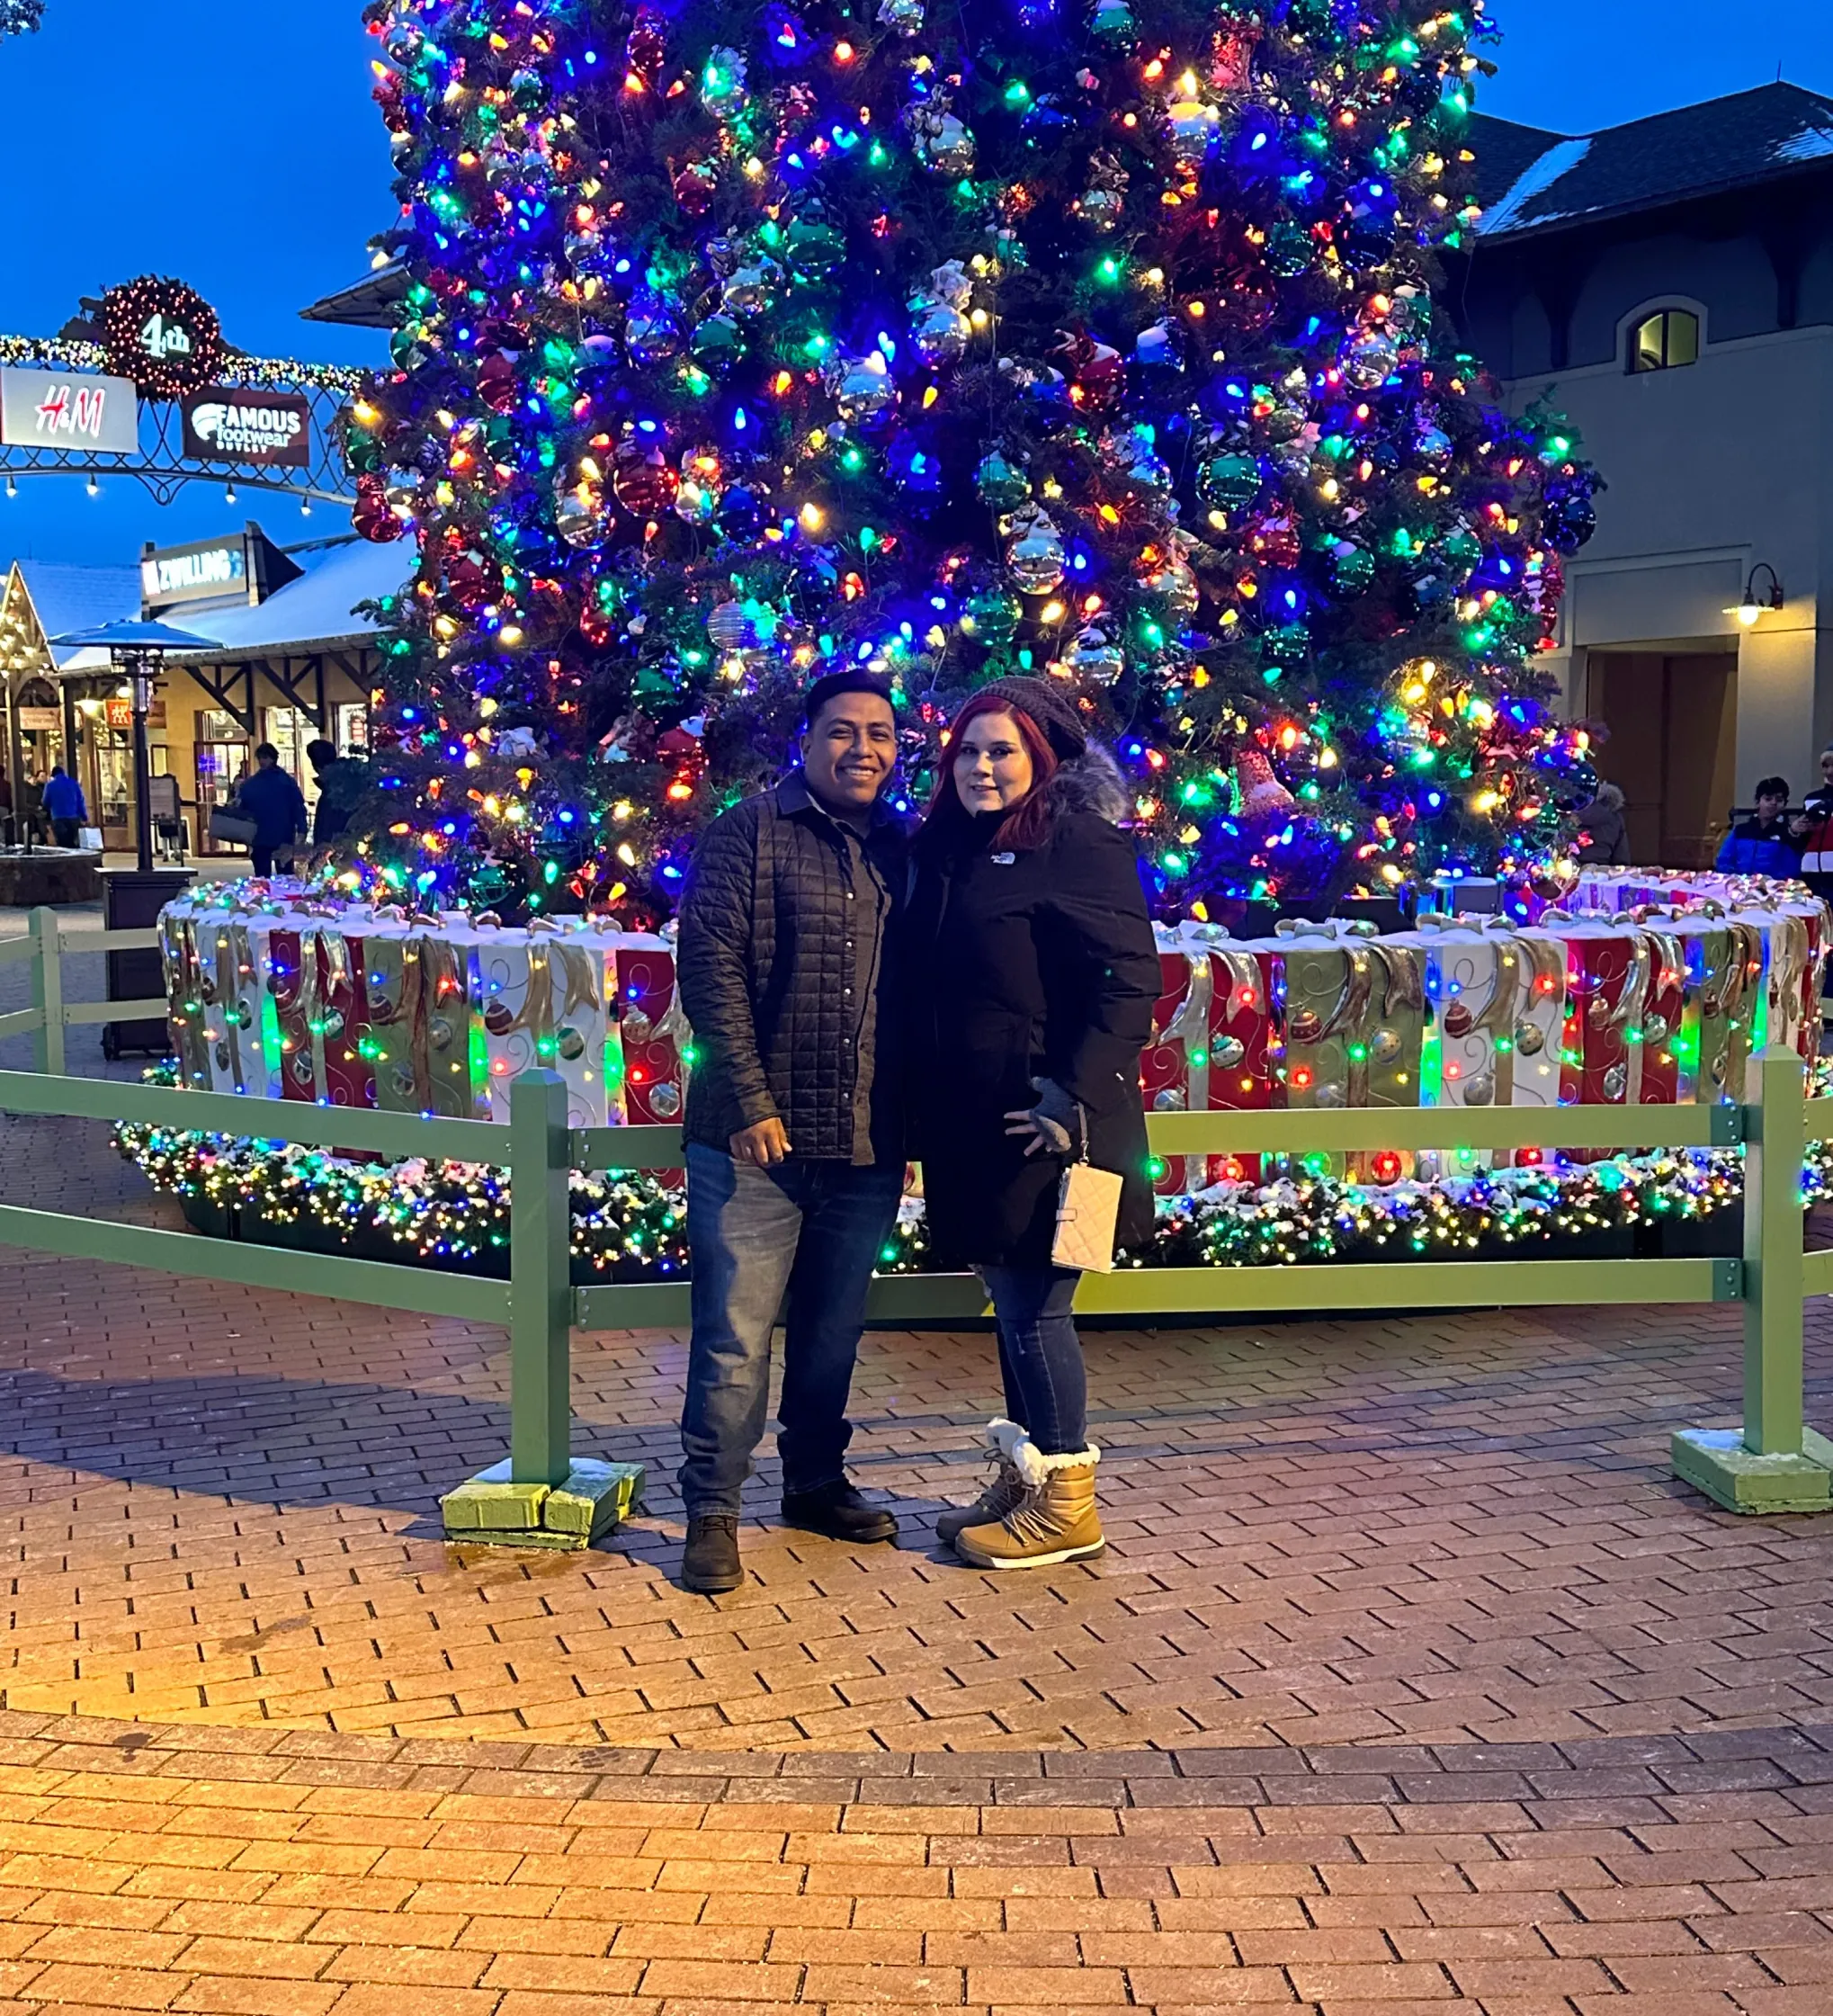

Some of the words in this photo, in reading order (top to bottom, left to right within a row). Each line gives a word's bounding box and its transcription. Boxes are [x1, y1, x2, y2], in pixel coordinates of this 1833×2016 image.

[140, 313, 190, 358] 4th
[35, 384, 106, 438] H&M
[216, 404, 301, 434] FAMOUS
[216, 424, 291, 448] footwear
[216, 441, 268, 454] OUTLET
